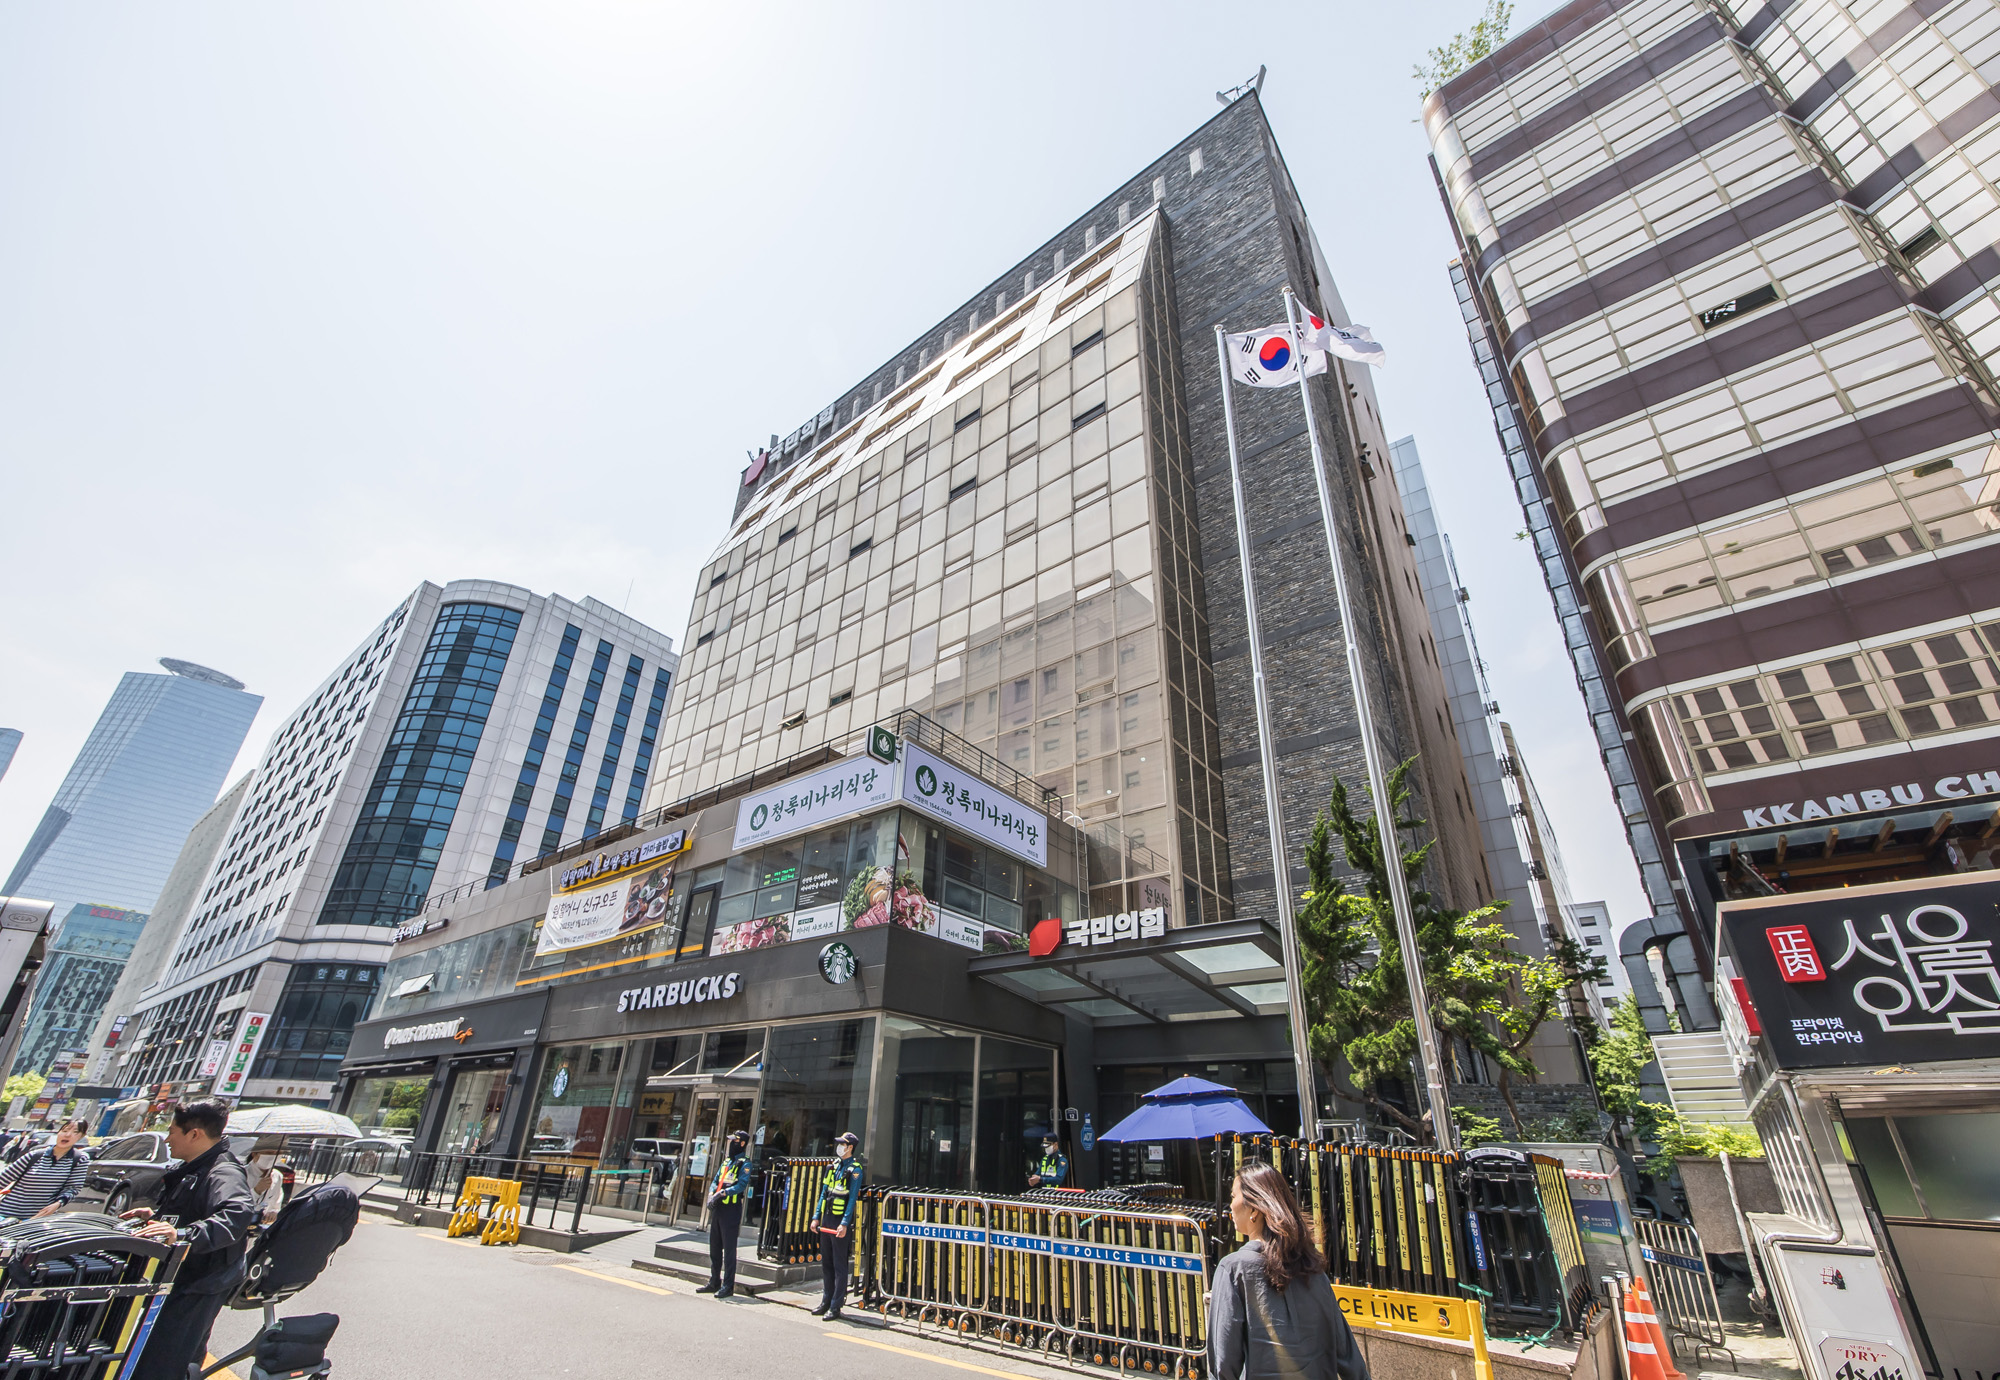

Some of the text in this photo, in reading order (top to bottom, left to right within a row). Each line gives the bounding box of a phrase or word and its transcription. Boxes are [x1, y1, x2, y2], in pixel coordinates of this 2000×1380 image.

[769, 402, 835, 464] 국민의힘
[770, 768, 879, 822] 청록미나리식당
[941, 780, 1039, 846] 청록미나리식당
[1742, 771, 2000, 828] KKANBU CH
[560, 862, 593, 888] 원할머니
[90, 907, 149, 923] KBIZ 중소
[552, 890, 618, 920] 원할머니 신규오픈
[1067, 906, 1165, 947] 국민의힘
[1830, 905, 1993, 978] 서울
[1773, 929, 1819, 977] 正肉
[617, 972, 740, 1013] STARBUCKS
[392, 1019, 462, 1046] PARIS CROISSANT
[1790, 1017, 1845, 1031] 프라이빗
[1795, 1031, 1864, 1046] 한우다이닝
[1344, 1173, 1352, 1214] POLICE
[1395, 1179, 1404, 1221] POLICE
[897, 1224, 969, 1241] POLICE LINE
[1371, 1176, 1384, 1255] 질서유지선
[1416, 1181, 1430, 1262] 질서유지선
[1437, 1183, 1453, 1266] POLICE LINE
[989, 1233, 1047, 1251] LICE LIN
[1074, 1246, 1178, 1268] POLICE LINE
[1644, 1249, 1692, 1269] POLICE LINE
[1371, 1300, 1419, 1323] LINE
